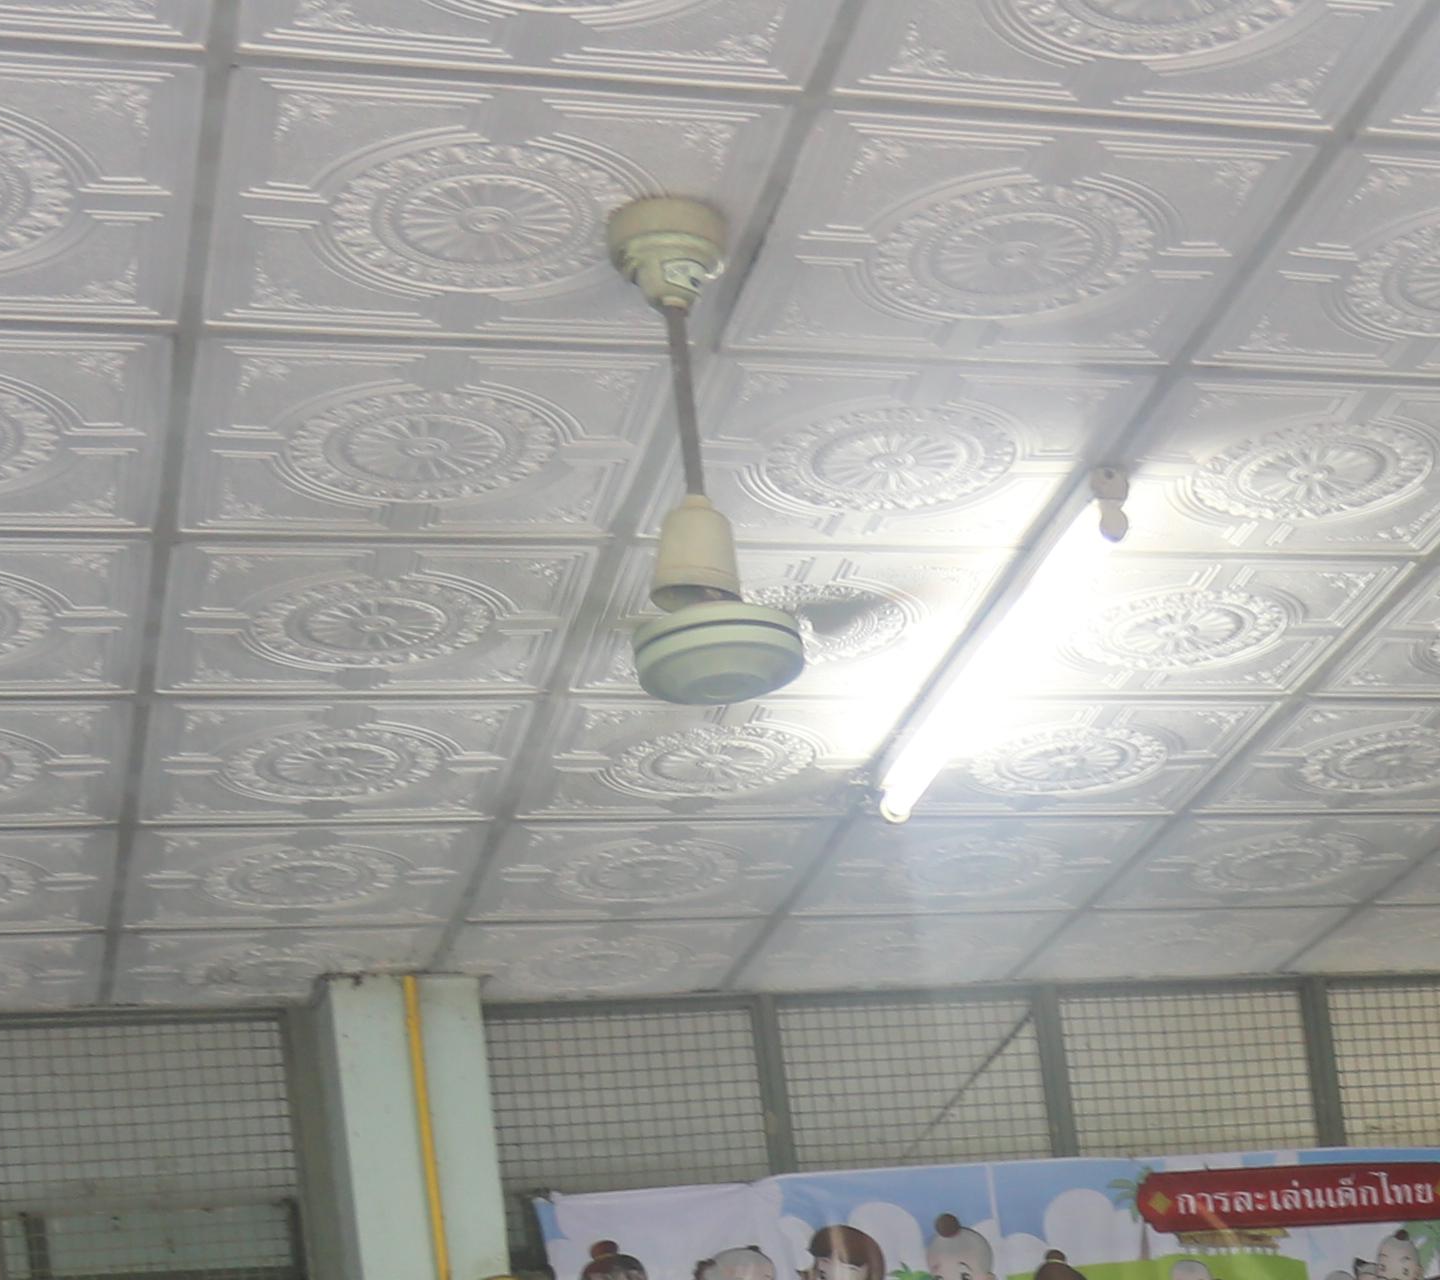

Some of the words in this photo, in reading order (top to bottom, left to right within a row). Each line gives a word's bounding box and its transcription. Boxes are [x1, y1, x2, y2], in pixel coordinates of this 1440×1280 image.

[1175, 1171, 1434, 1216] การละเล่นเด็กไทย
